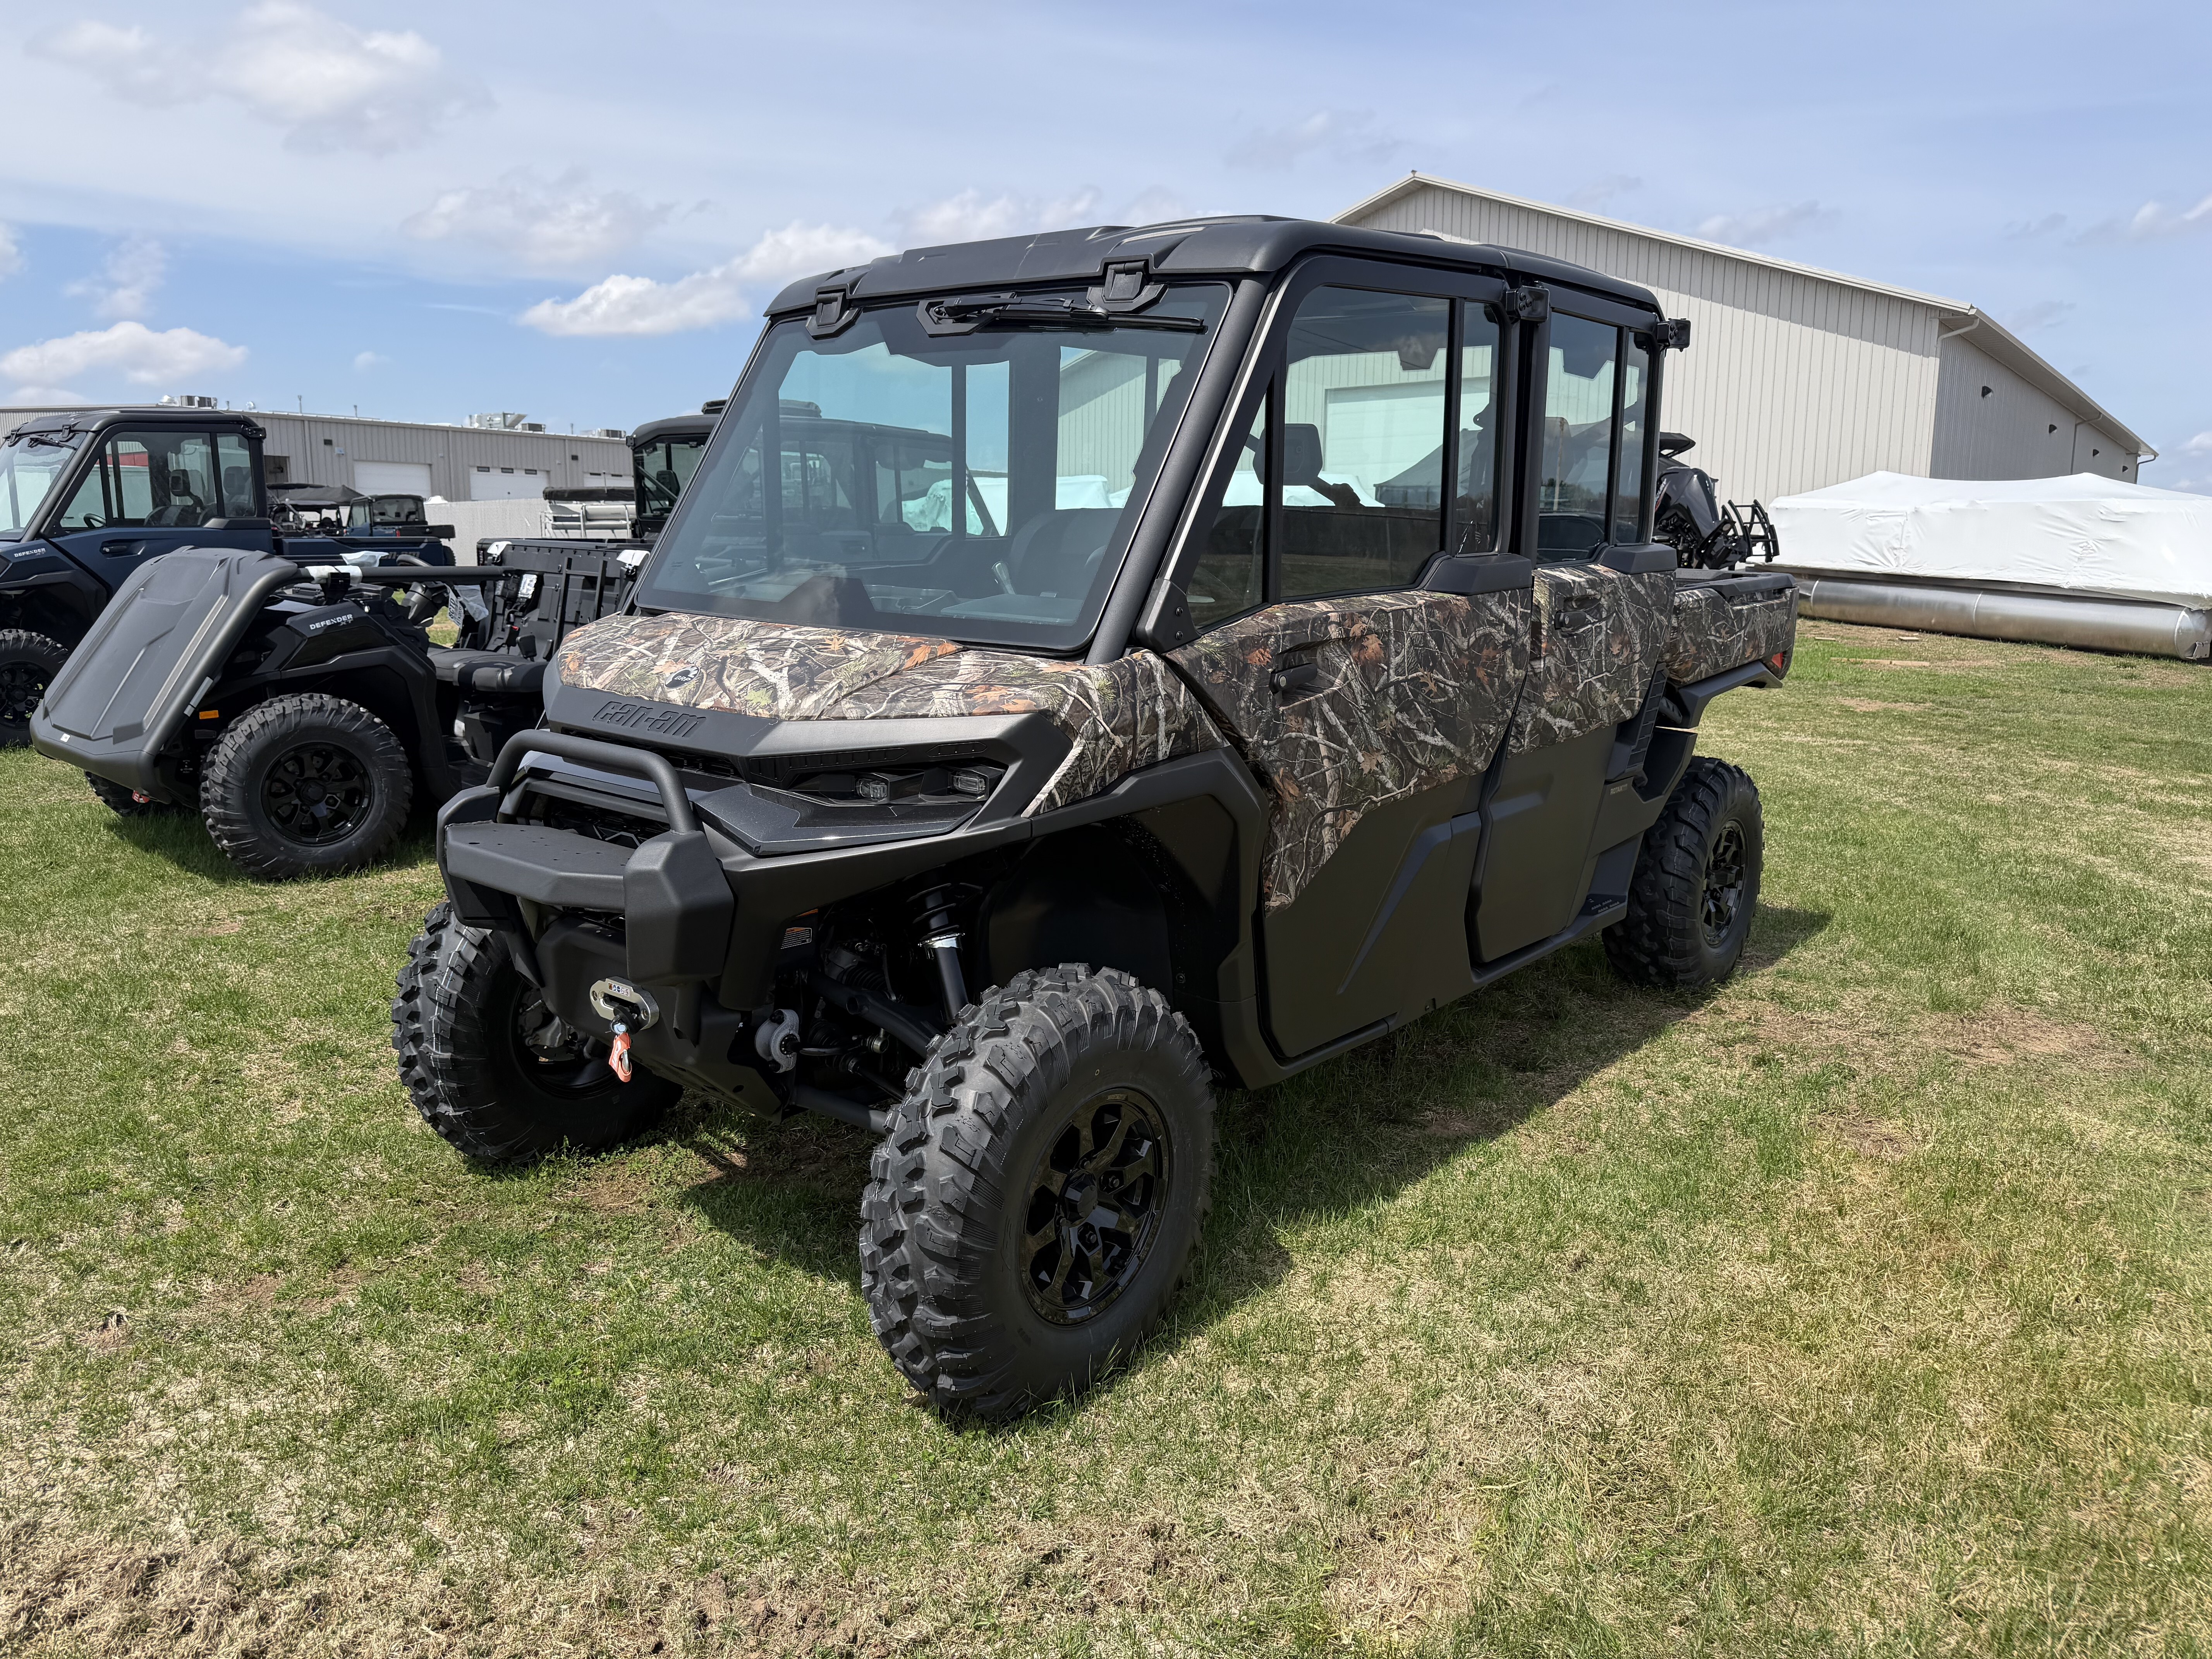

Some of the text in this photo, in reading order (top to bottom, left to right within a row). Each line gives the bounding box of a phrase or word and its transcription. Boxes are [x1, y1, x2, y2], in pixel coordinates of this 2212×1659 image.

[14, 548, 46, 557] DEFENDER
[309, 614, 353, 630] DEFENDER
[592, 701, 707, 738] can-am
